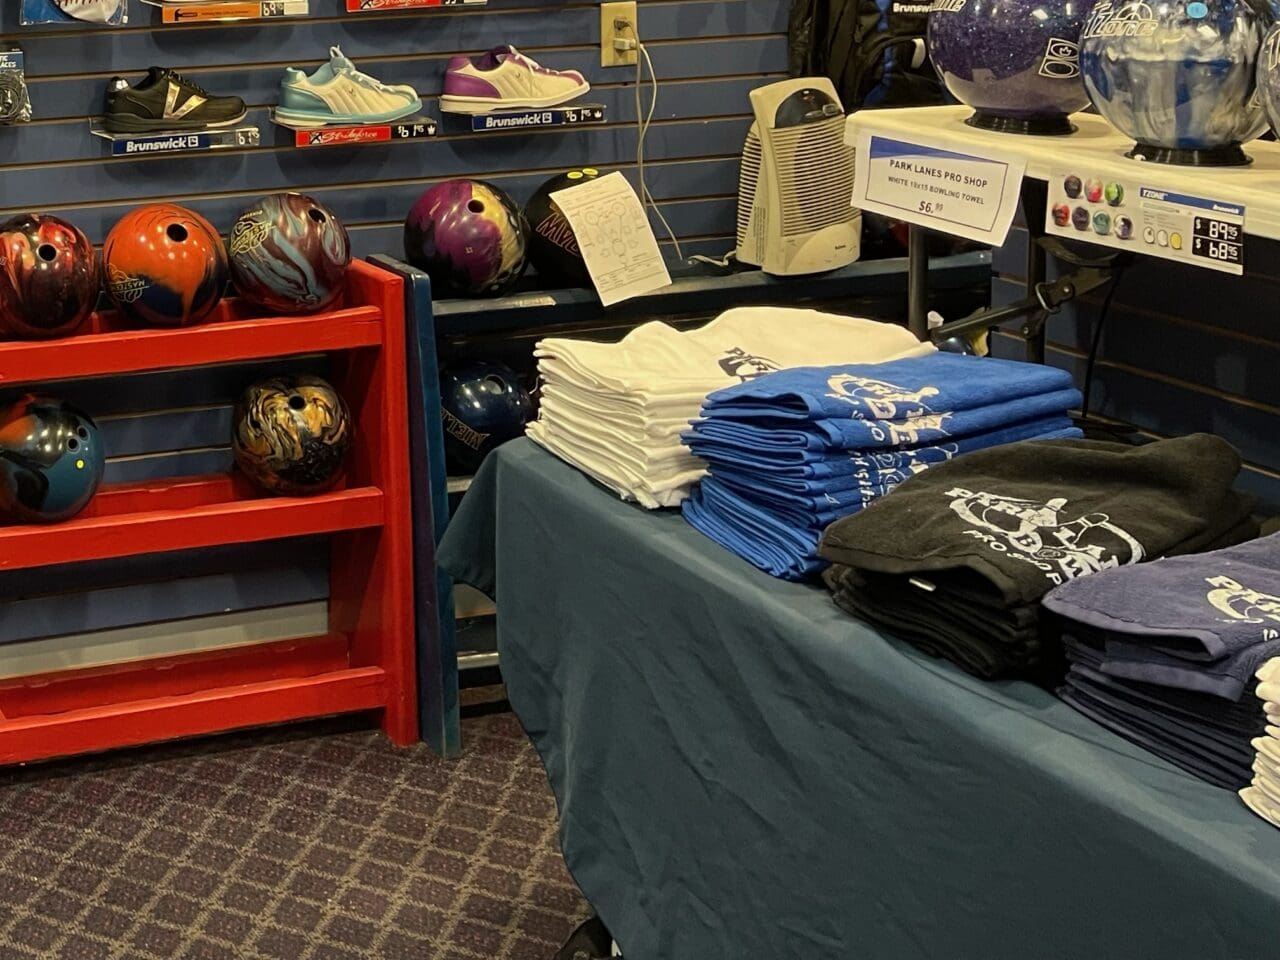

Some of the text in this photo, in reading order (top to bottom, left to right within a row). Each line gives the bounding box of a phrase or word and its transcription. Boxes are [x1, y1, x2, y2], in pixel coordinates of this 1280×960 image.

[486, 115, 541, 128] Brunswick
[323, 129, 378, 143] Strikeforce
[126, 138, 187, 152] Brunswick
[890, 159, 988, 189] PARK LANES PRO SHOP
[888, 175, 985, 205] WHITE BOWLING TOWEL
[1195, 219, 1201, 229] $
[1195, 238, 1201, 249] $
[962, 529, 1062, 586] PRO SHOP
